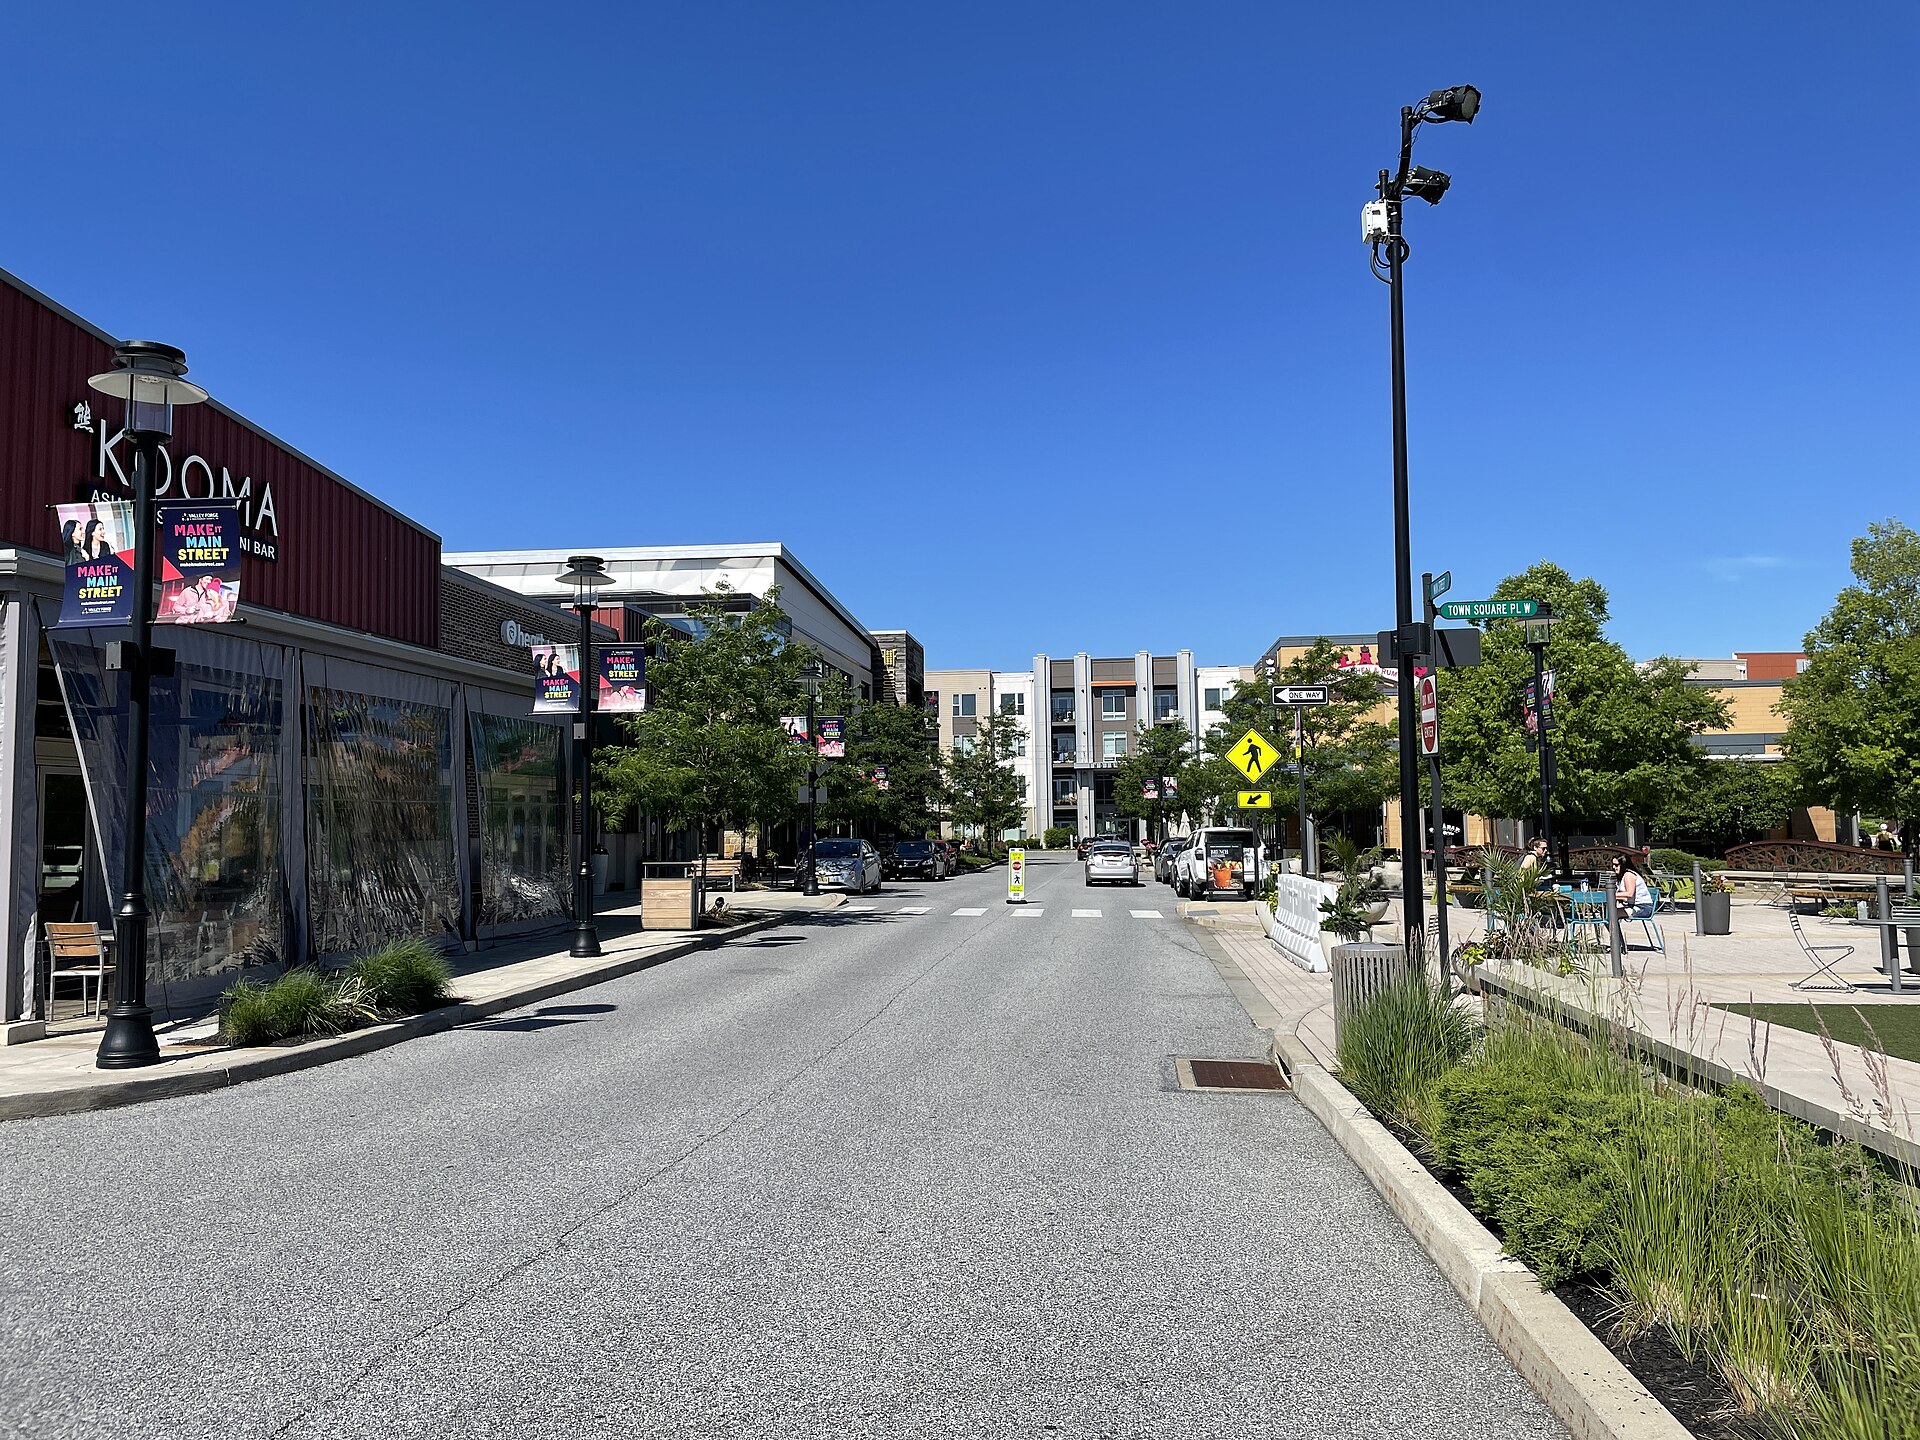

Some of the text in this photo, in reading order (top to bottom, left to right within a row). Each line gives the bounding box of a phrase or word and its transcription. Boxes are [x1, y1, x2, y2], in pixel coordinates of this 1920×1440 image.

[174, 524, 215, 537] MAKE
[185, 536, 222, 548] MAIN
[178, 548, 229, 561] STREET
[254, 541, 275, 559] BAR
[77, 565, 112, 577] MAKE
[86, 575, 117, 588] MAIN
[79, 586, 123, 599] STREET
[1448, 602, 1531, 616] TOWN SQUARE PL W
[606, 656, 631, 664] MAKE
[613, 663, 635, 671] MAIN
[608, 670, 639, 678] STREET
[543, 679, 565, 687] MAKE
[544, 691, 572, 699] STREET
[1288, 691, 1304, 699] ONE
